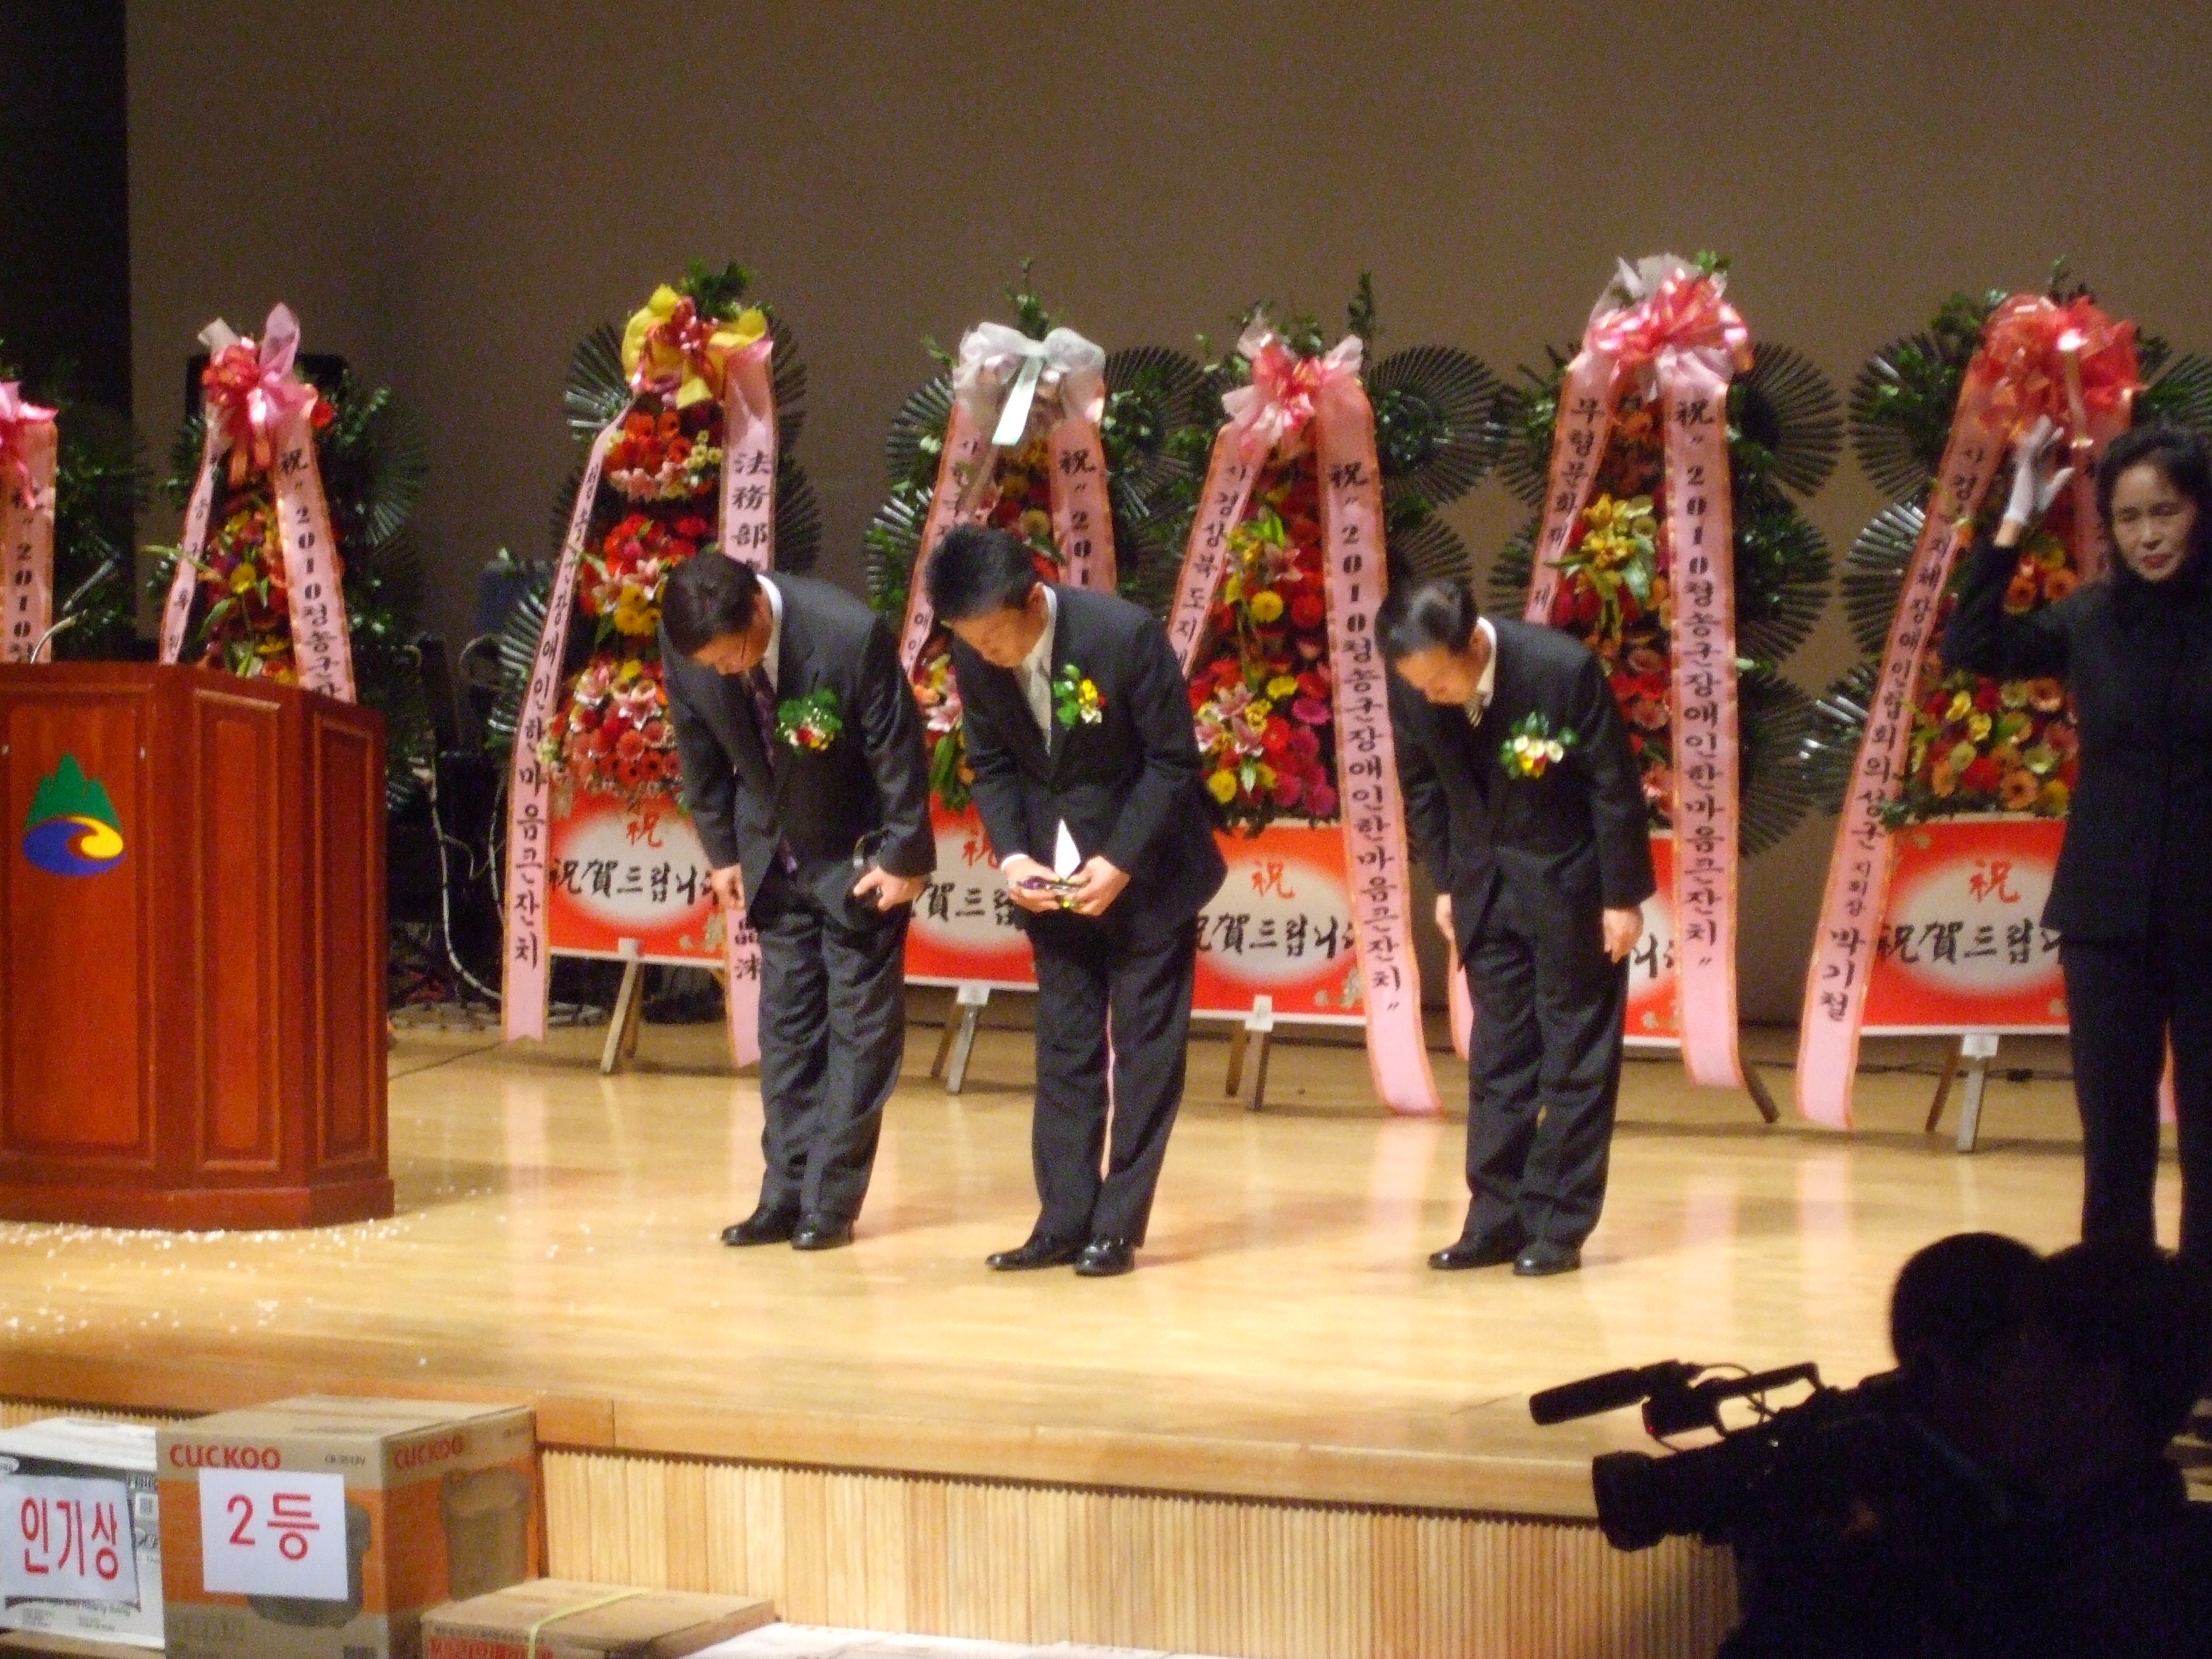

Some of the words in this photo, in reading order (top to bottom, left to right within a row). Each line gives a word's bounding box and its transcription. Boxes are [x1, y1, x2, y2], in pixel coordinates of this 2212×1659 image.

[731, 449, 769, 571] 法務部
[627, 804, 663, 849] 祝
[1251, 860, 1296, 899] 祝
[1969, 859, 2021, 903] 祝
[169, 1443, 281, 1470] CUCKOO
[393, 1435, 465, 1470] CUCKOO
[20, 1496, 119, 1580] 인기상
[226, 1493, 320, 1561] 2등
